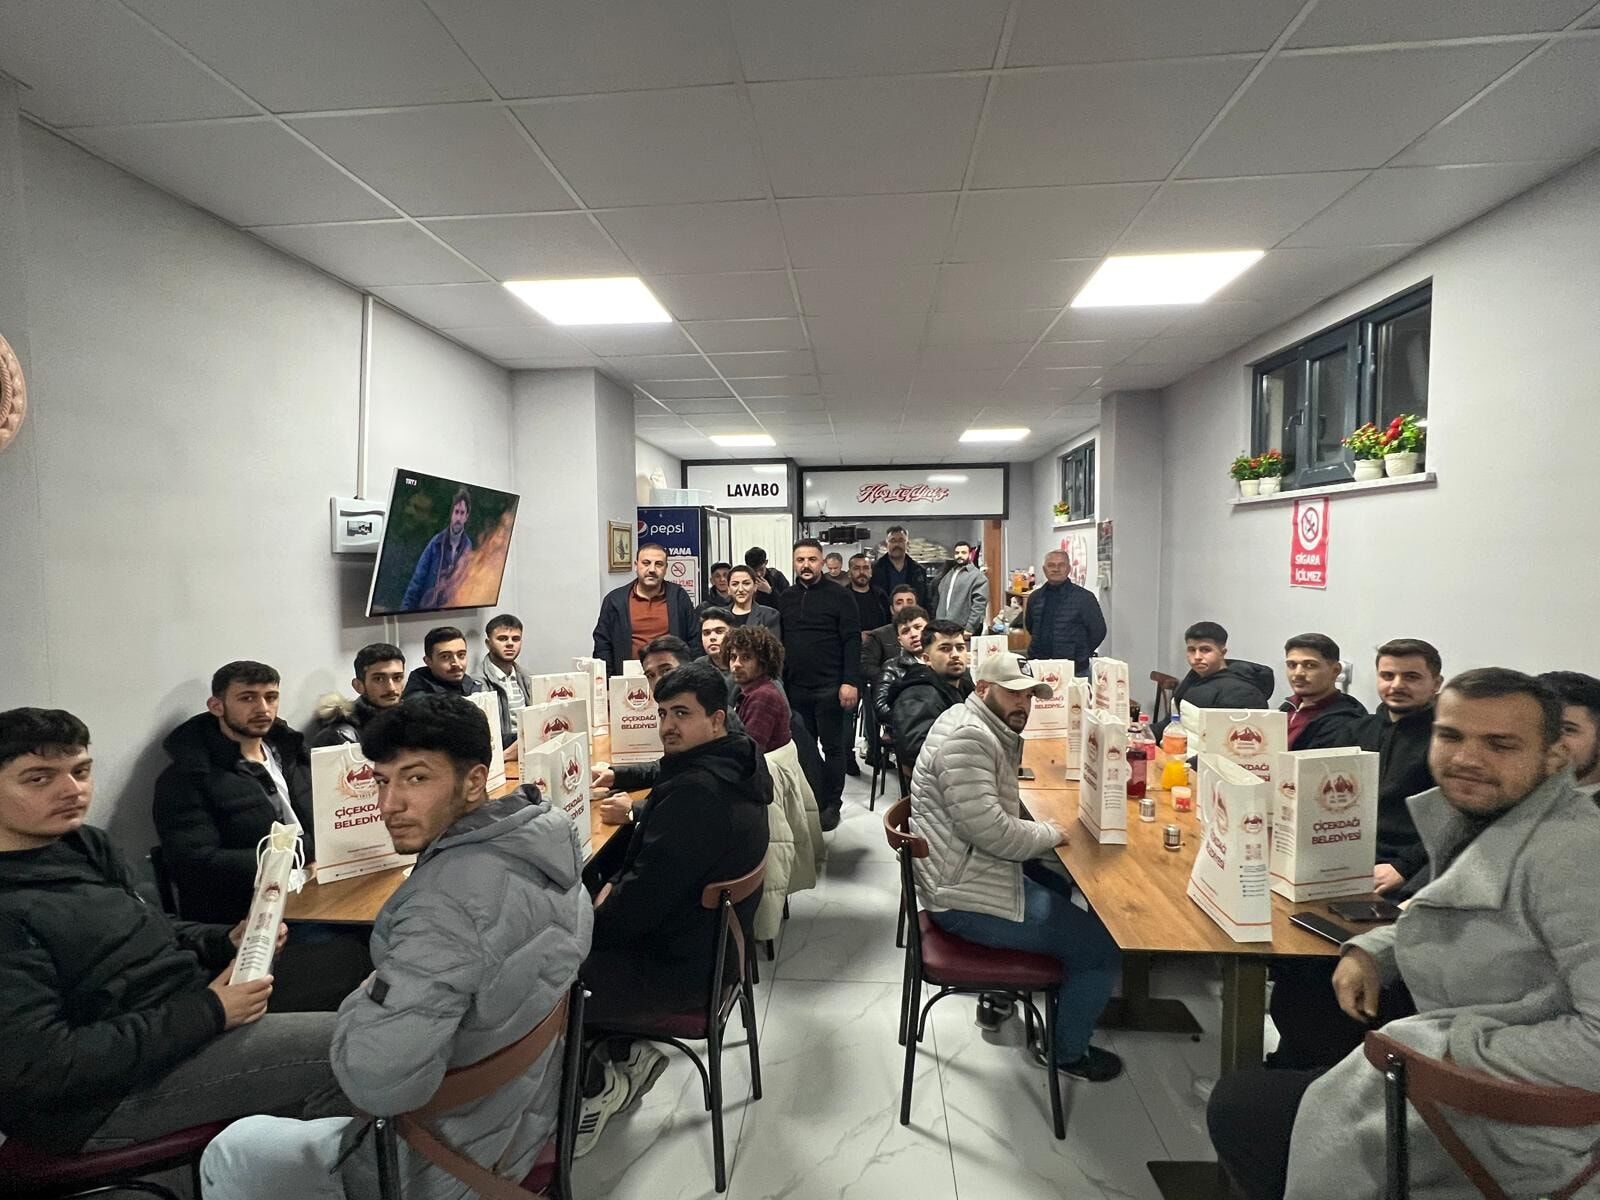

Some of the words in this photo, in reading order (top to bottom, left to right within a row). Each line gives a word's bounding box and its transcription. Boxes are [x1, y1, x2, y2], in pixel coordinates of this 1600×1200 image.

[727, 483, 779, 497] LAVABO
[650, 522, 685, 536] pepsi
[668, 547, 692, 556] YANA
[1312, 816, 1361, 833] ÇİÇEKDAĞI
[1311, 830, 1362, 845] BELEDİYESİ
